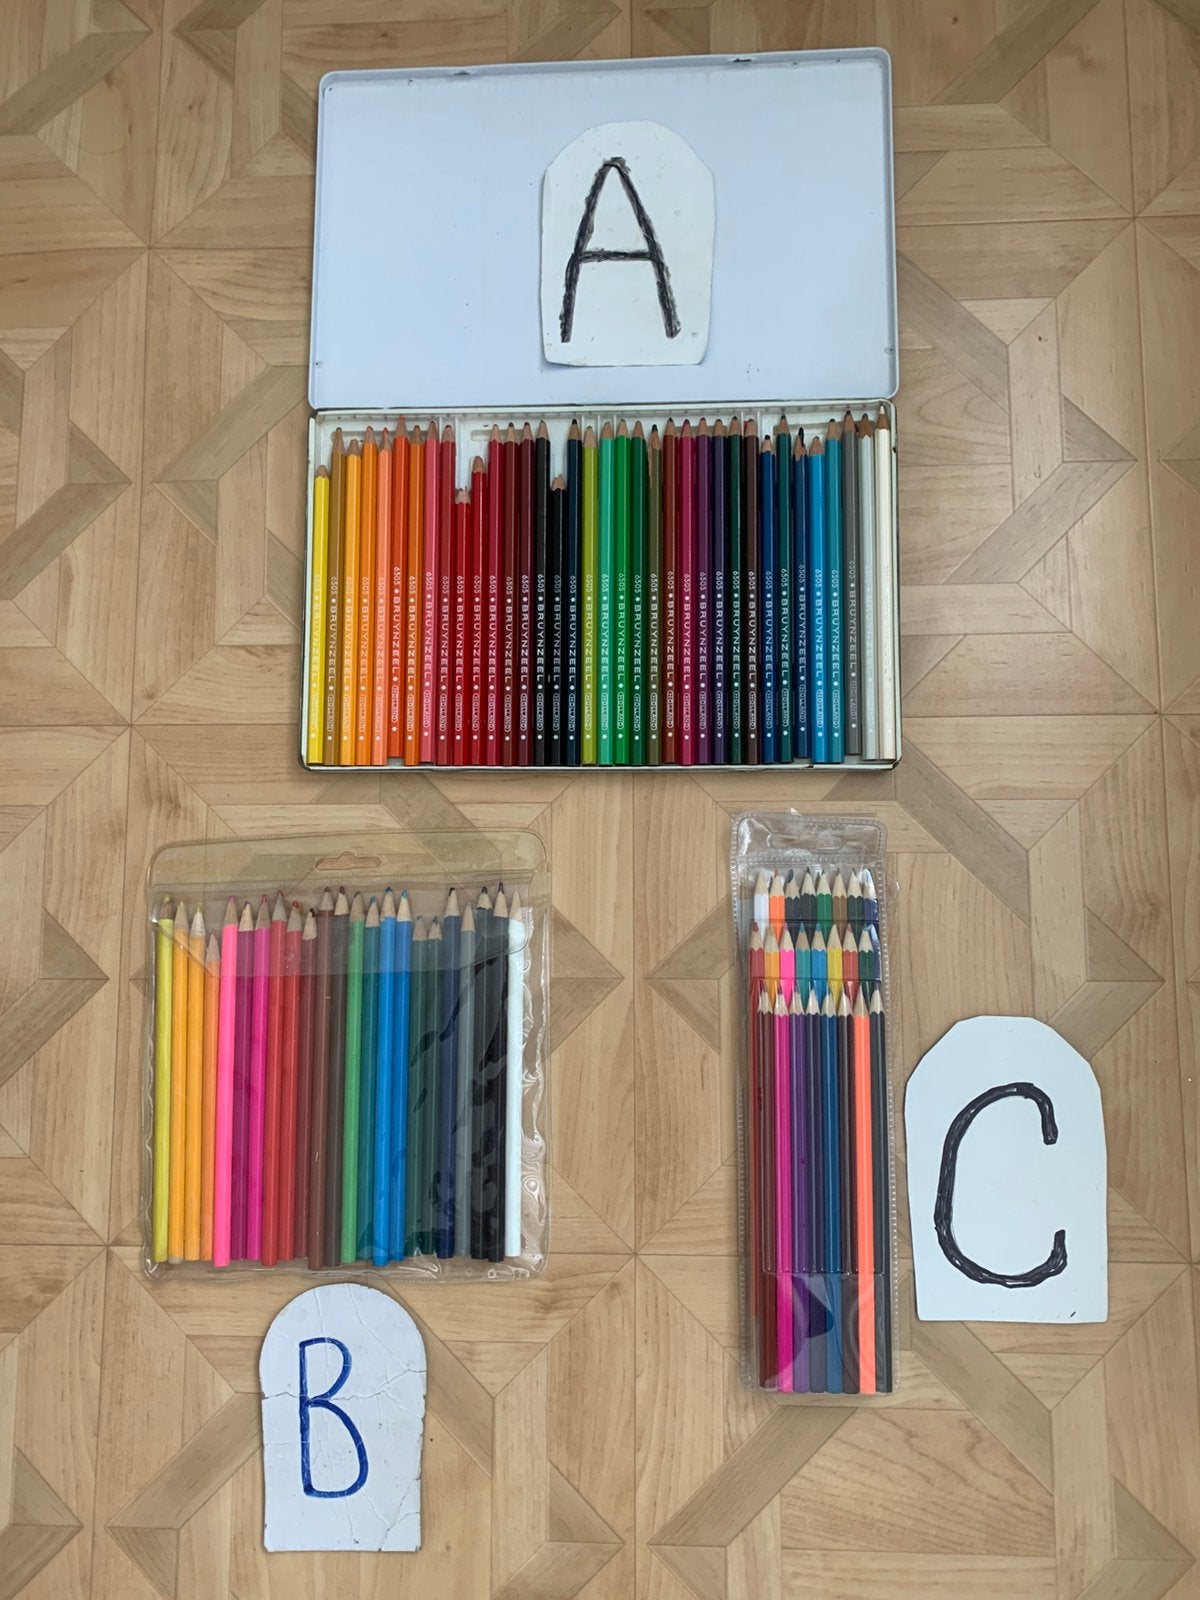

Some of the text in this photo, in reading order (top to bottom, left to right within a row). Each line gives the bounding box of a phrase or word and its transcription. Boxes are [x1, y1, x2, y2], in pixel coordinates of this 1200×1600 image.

[559, 156, 681, 343] A
[330, 576, 338, 595] 6505
[311, 603, 320, 680] BRUYNZEEL
[328, 606, 337, 683] BRUYNZEEL
[344, 606, 352, 683] BRUYNZEEL
[360, 606, 369, 683] BRUYNZEEL
[376, 606, 385, 683] BRUYNZEEL
[392, 596, 400, 673] BRUYNZEEL
[424, 601, 432, 678] BRUYNZEEL
[441, 605, 449, 682] BRUYNZEEL
[505, 606, 513, 683] BRUYNZEEL
[553, 604, 561, 681] BRUYNZEEL
[585, 604, 593, 681] BRUYNZEEL
[849, 590, 857, 669] BRUYNZEEL
[934, 1082, 1067, 1289] C
[299, 1337, 368, 1498] B
